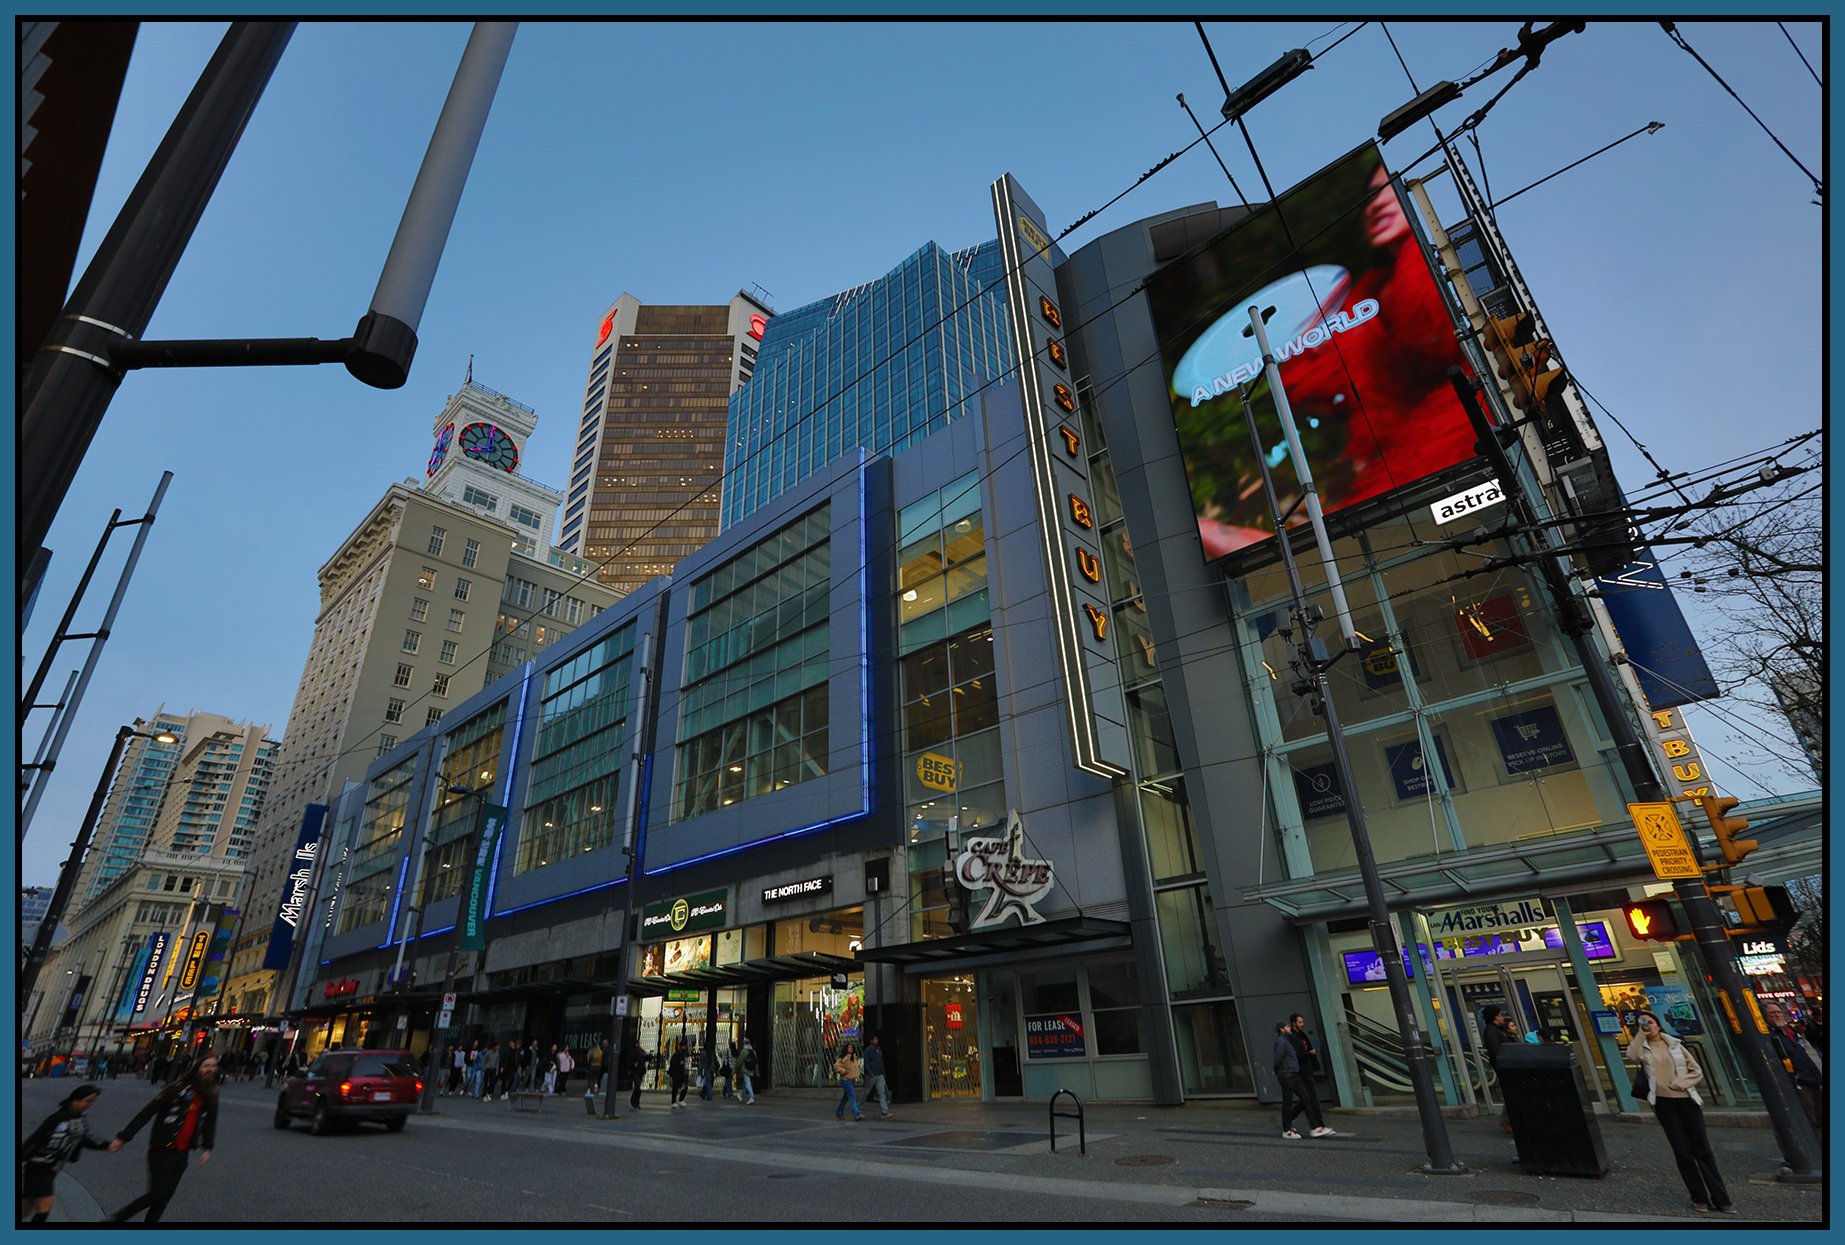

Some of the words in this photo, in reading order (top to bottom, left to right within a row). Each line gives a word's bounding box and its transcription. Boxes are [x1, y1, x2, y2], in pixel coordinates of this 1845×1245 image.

[1191, 383, 1214, 407] A
[1212, 355, 1265, 395] NEW
[1275, 298, 1379, 363] WORLD
[1039, 295, 1080, 458] BEST
[1068, 493, 1109, 643] BUY
[1507, 748, 1536, 760] RESERVE
[1536, 743, 1564, 754] ONLINE
[923, 758, 955, 775] BES
[1662, 739, 1708, 806] BUY
[923, 770, 956, 788] BUY
[1403, 776, 1420, 786] SHOP
[1309, 799, 1324, 808] LOW
[1651, 849, 1688, 857] PEDESTRIAN
[1660, 857, 1687, 865] PRIORITY
[961, 854, 1051, 896] CRÊPE
[1662, 866, 1693, 874] CROSSING
[764, 888, 778, 900] THE
[778, 883, 803, 898] NORTH
[803, 879, 822, 892] FACE
[467, 868, 482, 937] VANCOUVER
[1440, 901, 1545, 933] Marshalls
[1441, 933, 1494, 950] BEST
[1498, 927, 1550, 944] BUY
[1743, 941, 1776, 955] Lids
[147, 935, 164, 975] LONDON
[136, 976, 152, 1011] DRUGS
[1028, 1021, 1042, 1032] FOR
[1043, 1019, 1066, 1031] LEASE
